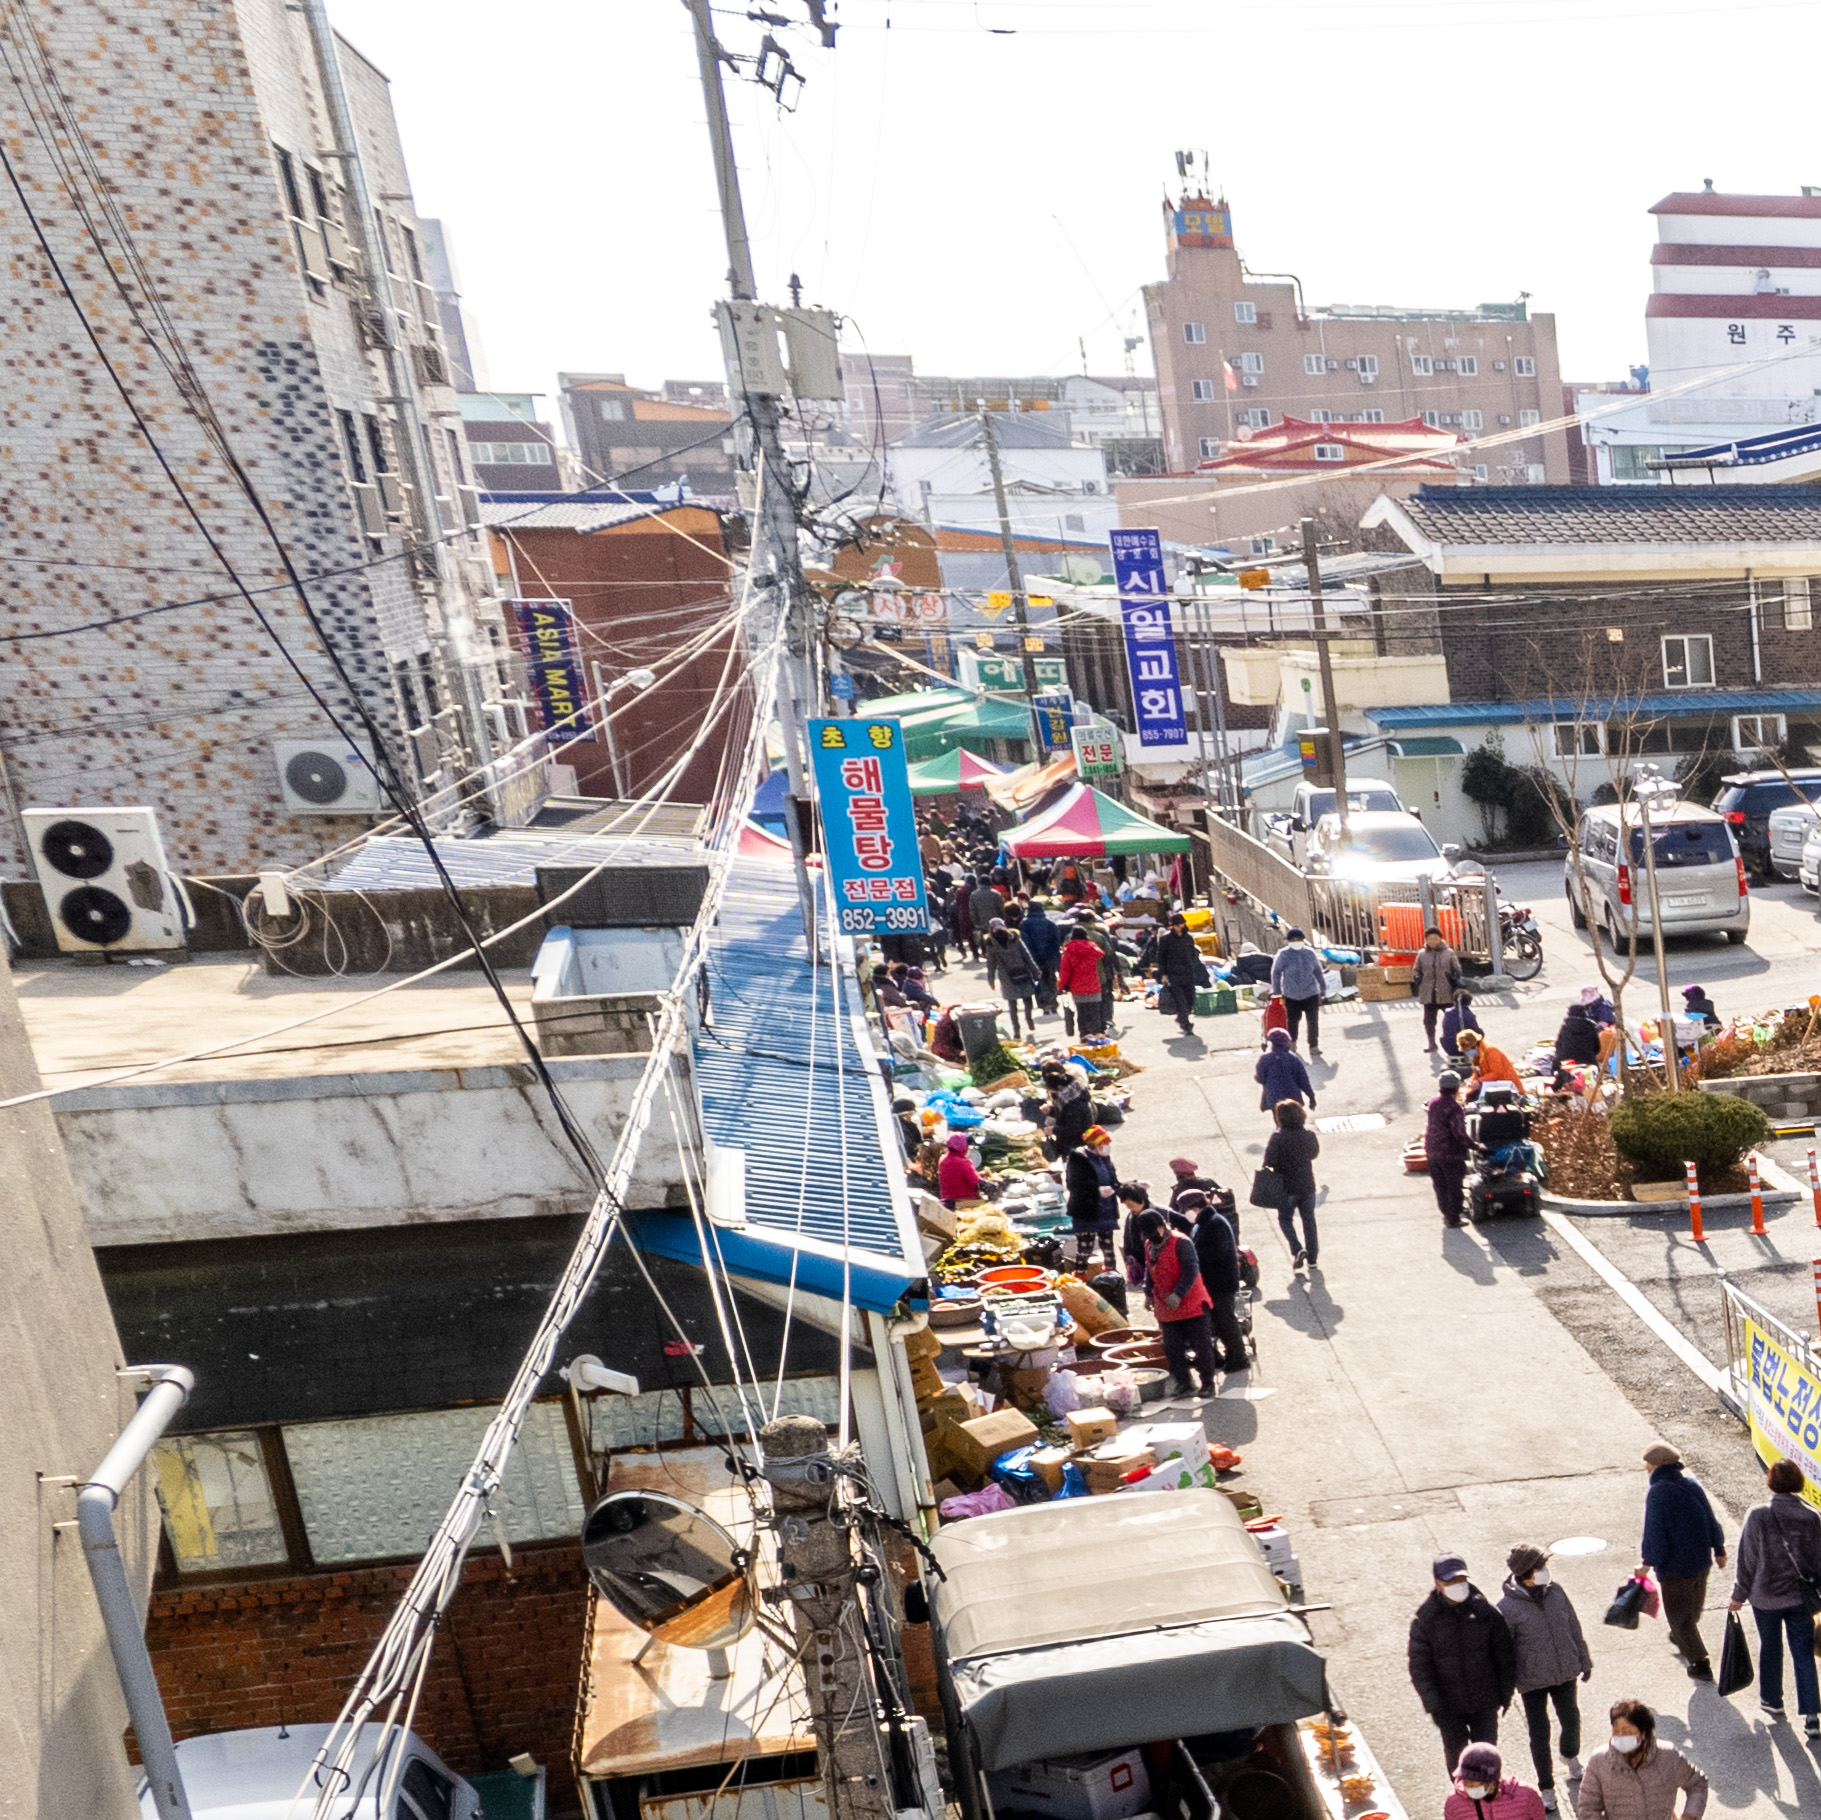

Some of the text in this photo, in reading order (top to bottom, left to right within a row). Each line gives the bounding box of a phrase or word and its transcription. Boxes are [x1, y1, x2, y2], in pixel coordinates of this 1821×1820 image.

[532, 612, 559, 663] ASIA
[1124, 570, 1178, 720] 신일교회
[545, 669, 577, 727] MART
[820, 725, 893, 749] 초향
[1081, 744, 1114, 764] 전문
[841, 756, 894, 872] 해물탕
[843, 877, 917, 901] 전문점
[841, 906, 927, 931] 852-3991
